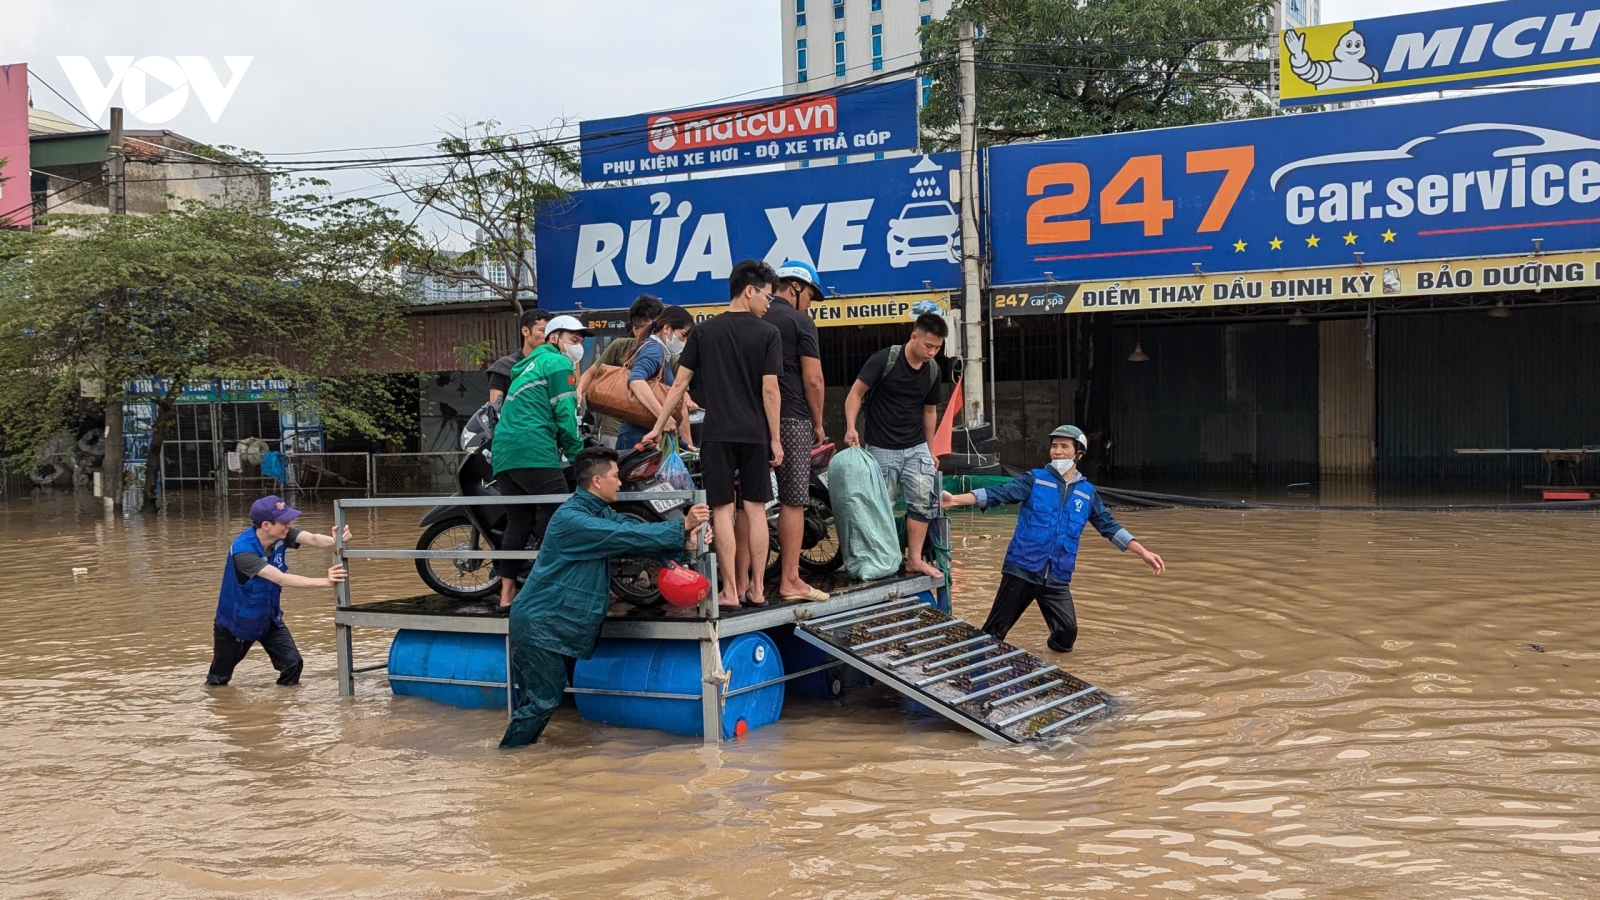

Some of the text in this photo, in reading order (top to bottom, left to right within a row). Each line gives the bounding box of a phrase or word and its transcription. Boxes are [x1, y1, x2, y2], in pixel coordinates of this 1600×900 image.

[1383, 9, 1600, 73] MICH
[684, 104, 834, 144] matcu.vn
[603, 160, 635, 175] PHỤ
[640, 155, 679, 172] KIỆN
[683, 152, 705, 166] XE
[710, 148, 738, 163] HƠI
[755, 142, 779, 159] ĐỘ
[784, 140, 807, 155] XE
[812, 132, 848, 151] TRẢ
[853, 130, 892, 147] GÓP
[1027, 145, 1600, 245] 247 car.service
[571, 191, 875, 289] RỬA XE
[995, 293, 1029, 308] 247
[1047, 297, 1064, 308] spa
[1082, 282, 1140, 307] ĐIỂM
[1148, 284, 1205, 304] THAY
[1213, 276, 1263, 300] DẦU
[1269, 276, 1332, 301] ĐỊNH
[1342, 271, 1375, 294] KỲ
[1417, 264, 1473, 290] BẢO
[1483, 261, 1584, 287] DƯỠNG
[588, 320, 608, 329] 247
[847, 300, 909, 319] NGHIỆP
